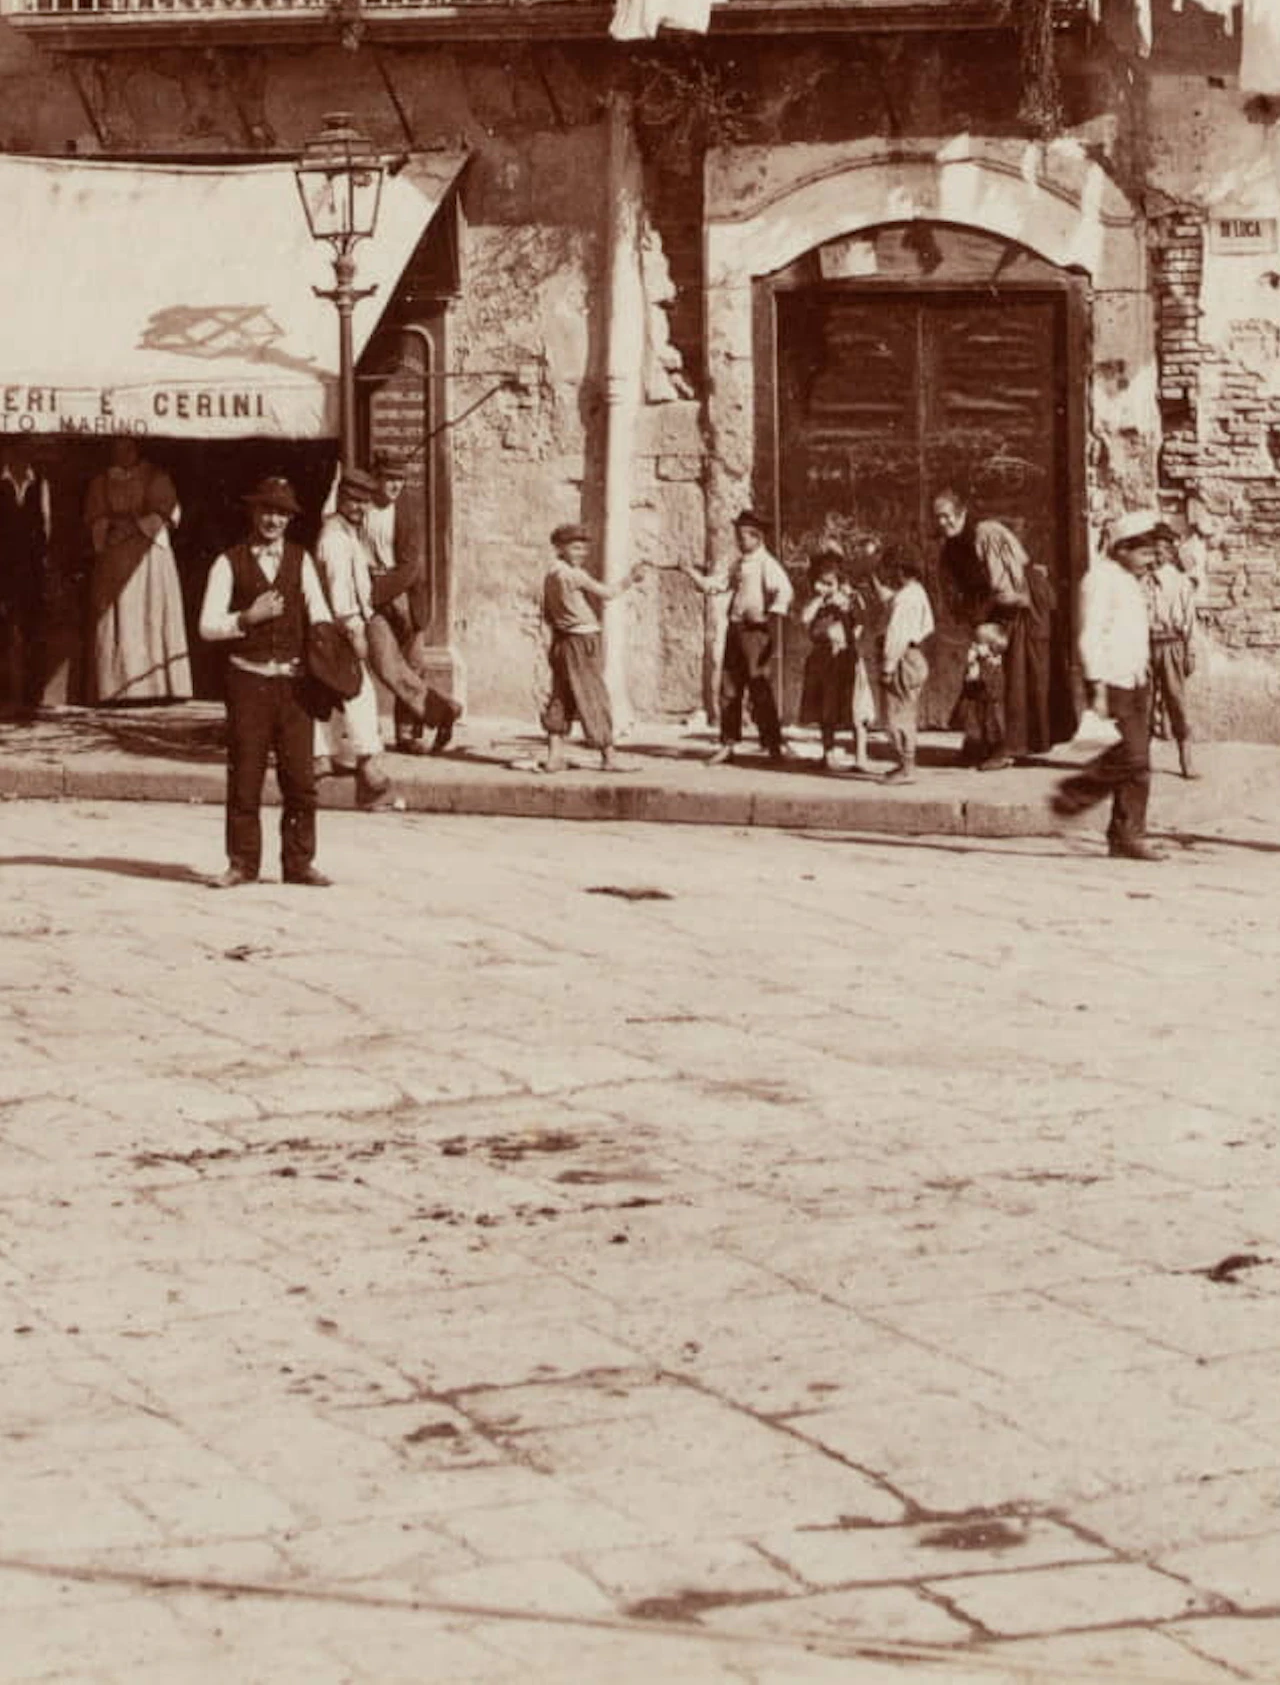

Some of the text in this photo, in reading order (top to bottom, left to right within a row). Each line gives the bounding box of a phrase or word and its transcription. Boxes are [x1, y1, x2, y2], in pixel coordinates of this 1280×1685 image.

[100, 388, 114, 416] E
[153, 391, 264, 420] CERINI
[59, 415, 149, 438] MARINO
